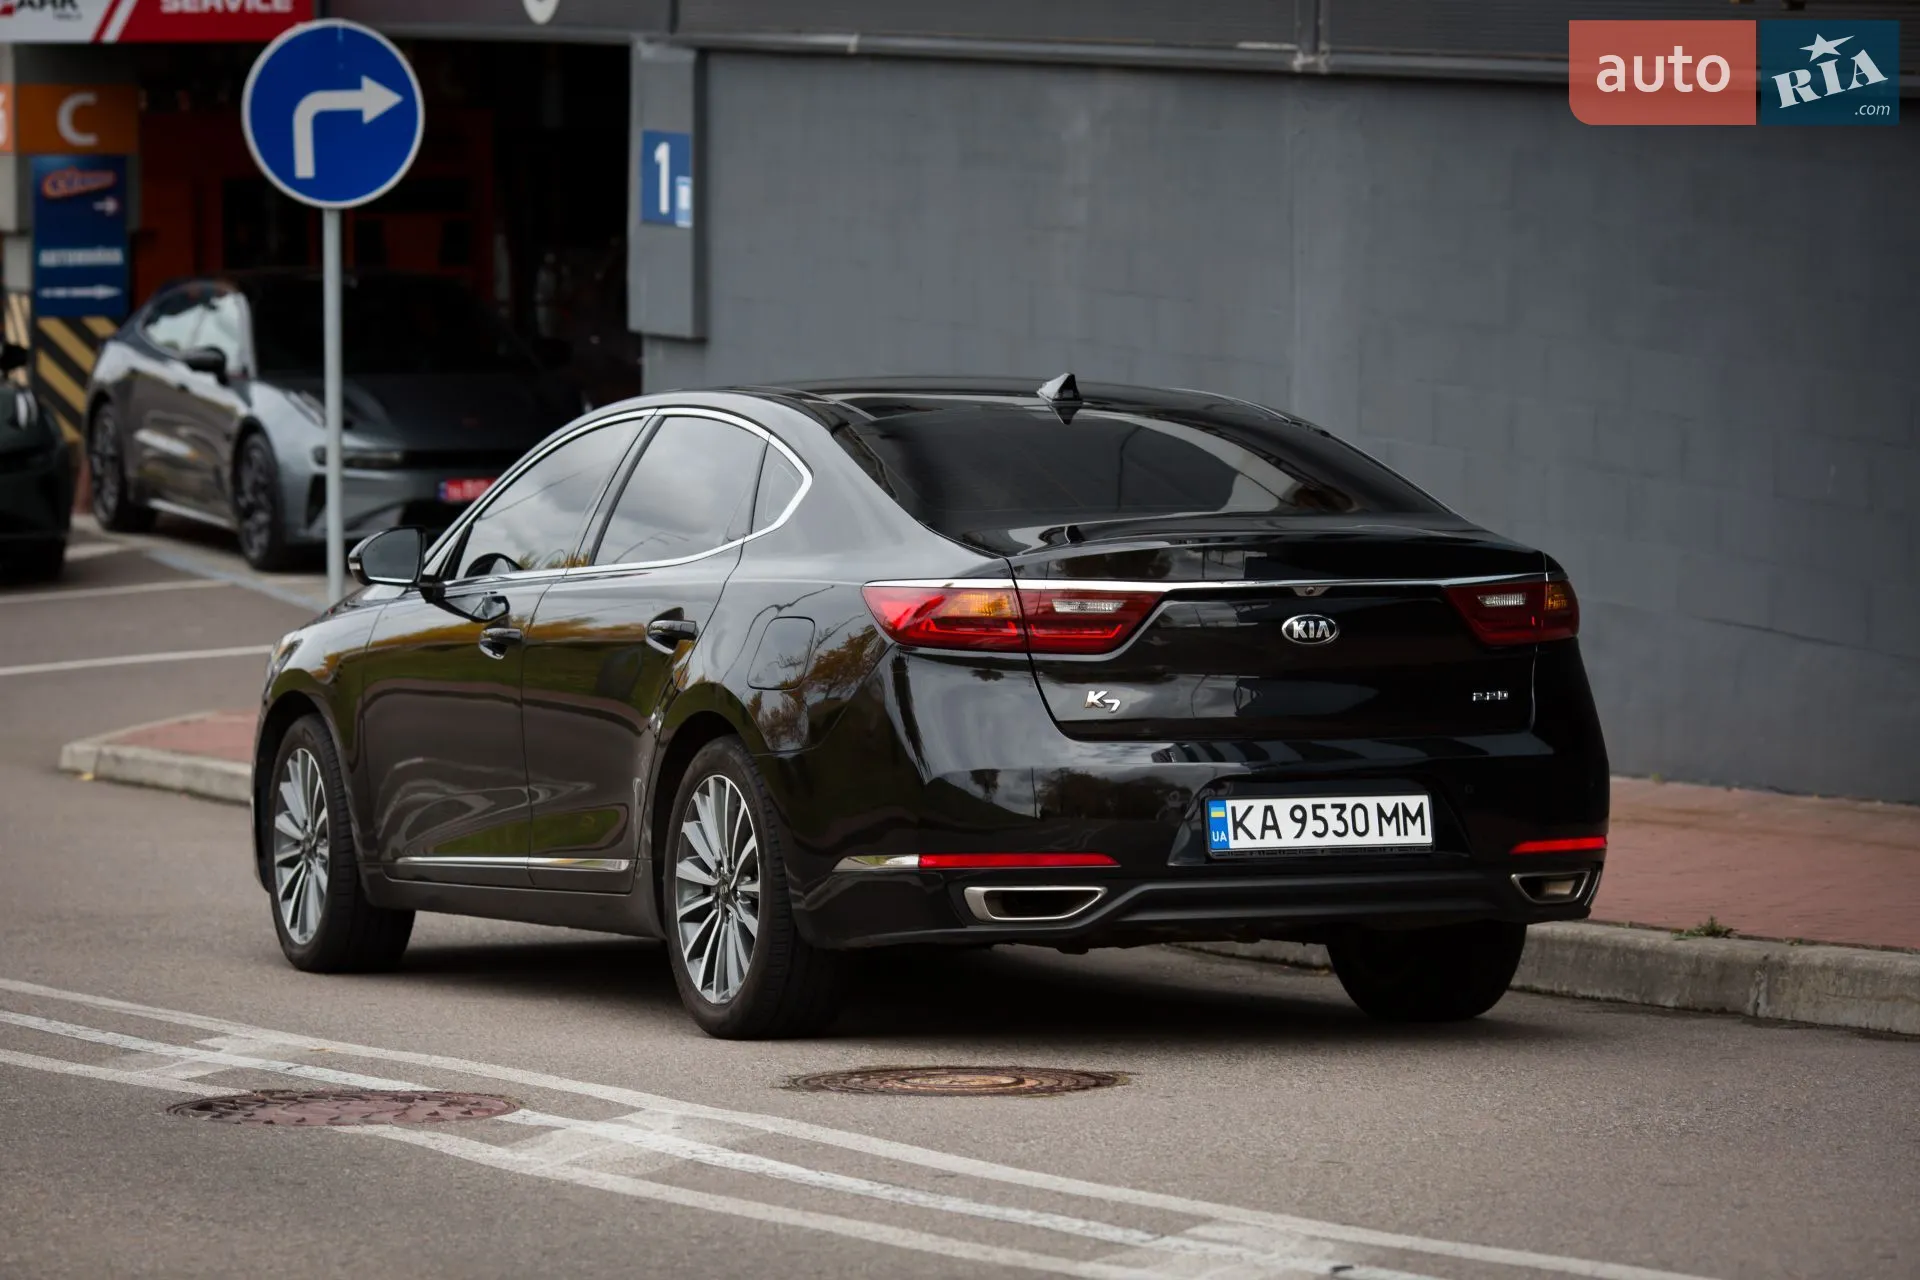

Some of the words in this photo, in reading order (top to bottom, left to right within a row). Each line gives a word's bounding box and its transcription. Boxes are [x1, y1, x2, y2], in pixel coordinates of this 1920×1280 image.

[654, 141, 670, 214] 1
[1292, 621, 1331, 639] KIA
[1084, 690, 1121, 713] K7
[1231, 804, 1283, 841] KA
[1289, 802, 1370, 839] 9530
[1376, 801, 1427, 838] MM
[1212, 830, 1228, 843] UA
